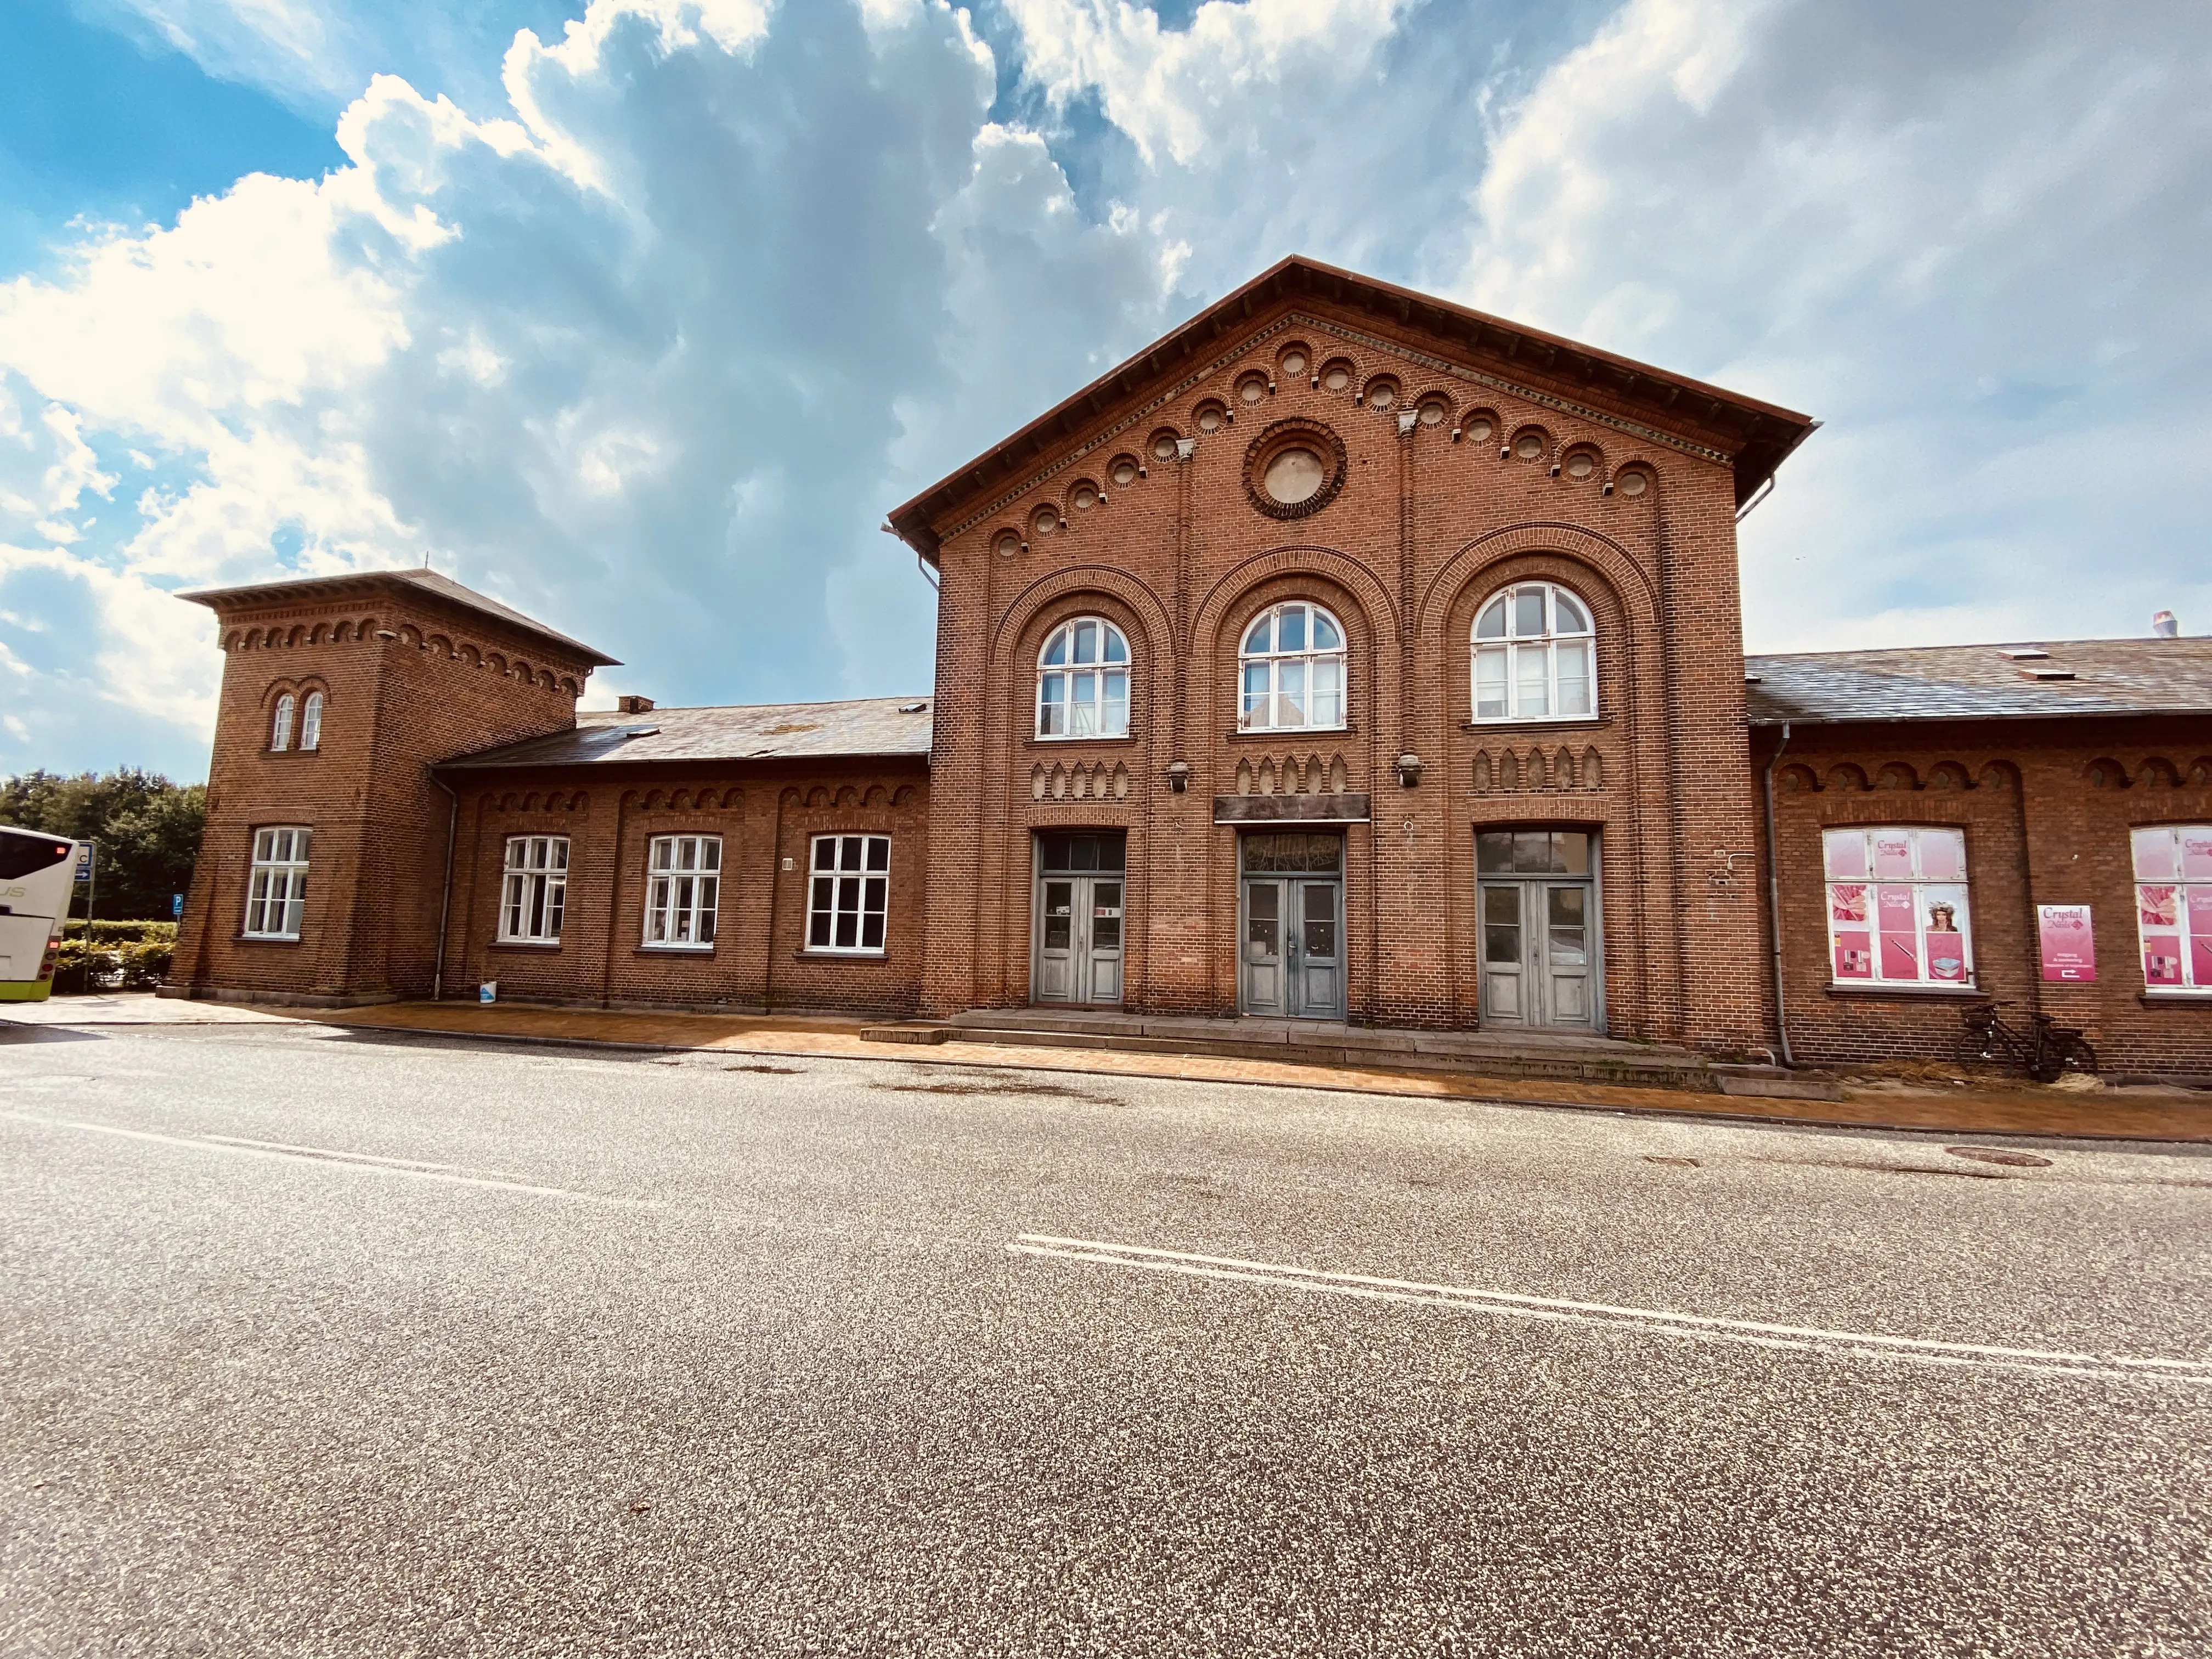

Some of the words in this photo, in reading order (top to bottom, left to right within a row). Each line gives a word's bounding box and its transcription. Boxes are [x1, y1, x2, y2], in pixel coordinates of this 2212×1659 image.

[80, 855, 88, 863] C
[176, 896, 182, 906] P
[1881, 891, 1910, 902] Crystal
[2043, 907, 2083, 922] Crystal
